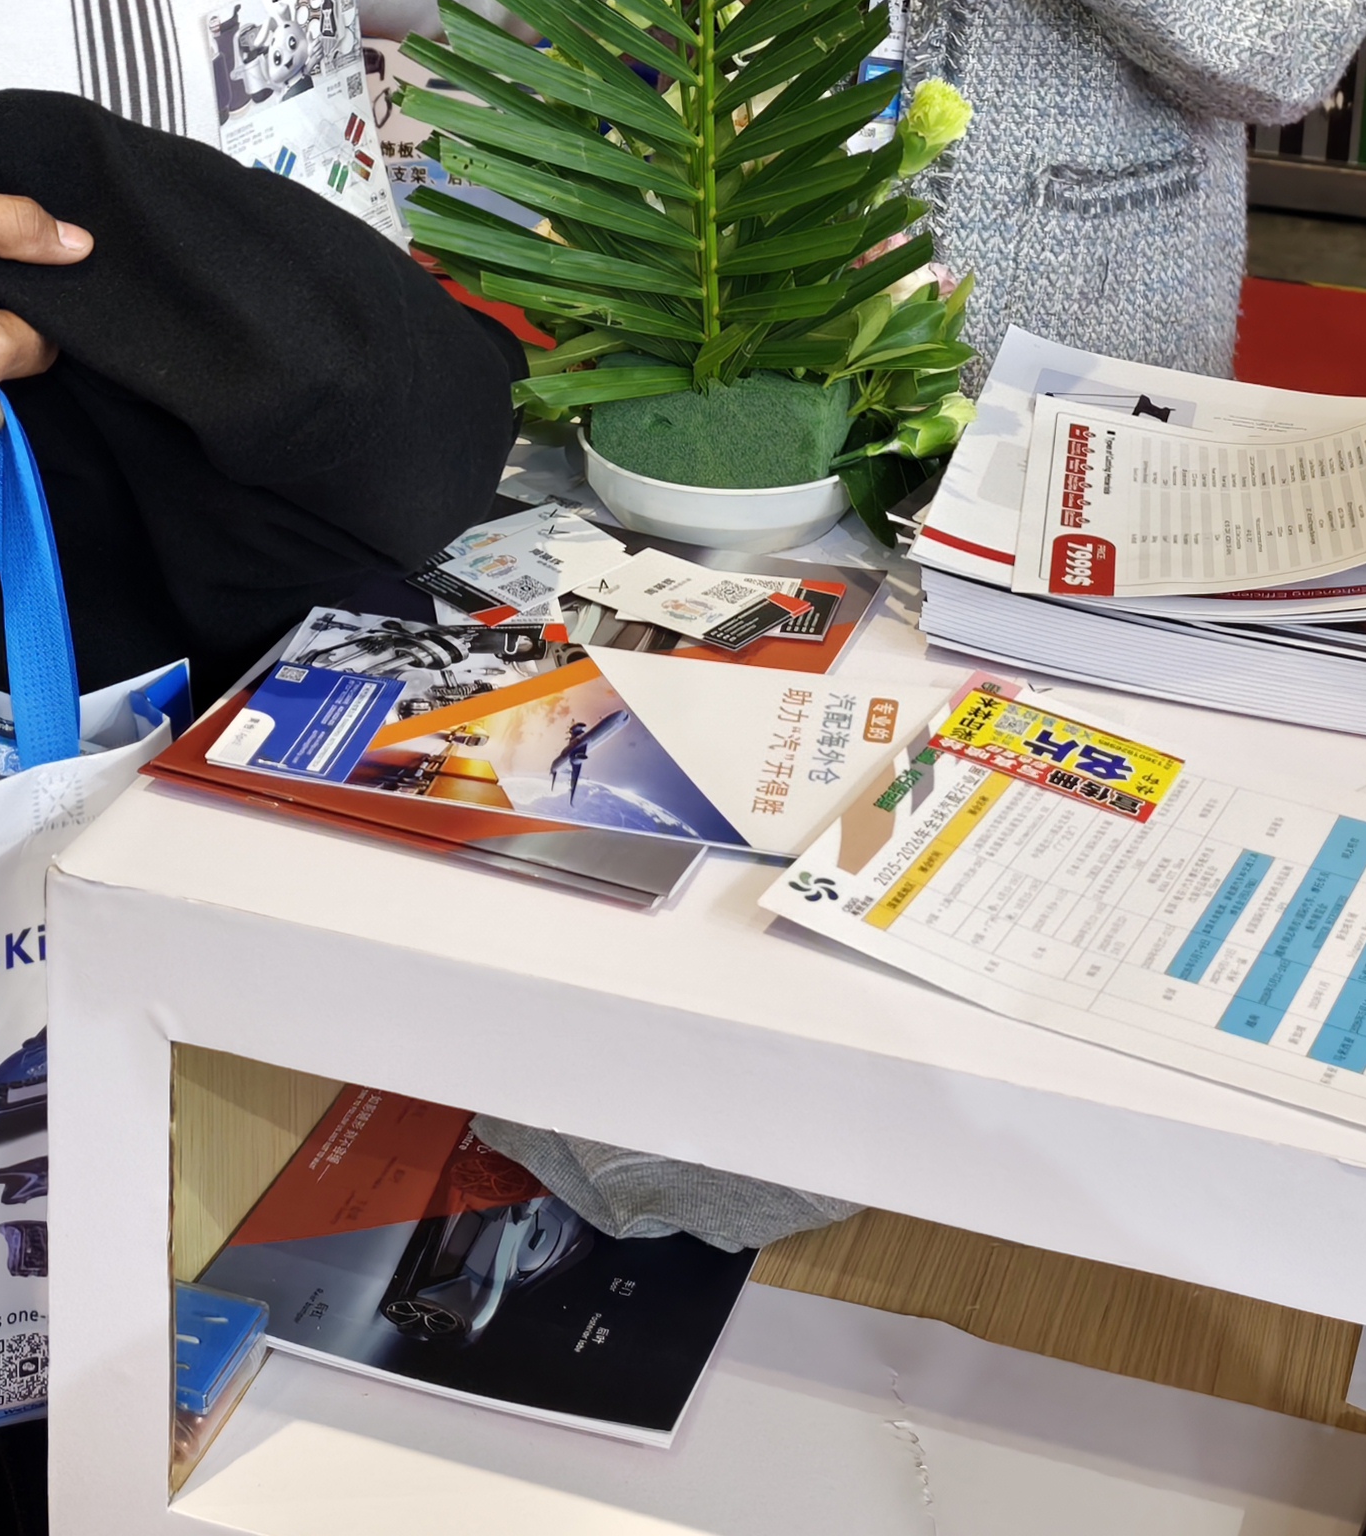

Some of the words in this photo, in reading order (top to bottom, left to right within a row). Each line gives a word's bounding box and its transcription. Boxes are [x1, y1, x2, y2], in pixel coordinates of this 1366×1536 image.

[1061, 542, 1094, 586] 7999$
[807, 691, 859, 786] 汽配海外仓
[866, 702, 895, 740] 专业的
[947, 694, 1004, 742] 彩印样本
[751, 687, 814, 815] 助力“汽”开得胜
[1016, 726, 1140, 786] 名片
[1040, 768, 1148, 815] 宣传册
[1131, 770, 1164, 796] 快印
[862, 765, 995, 886] 2025-2026年全球汽配行业展
